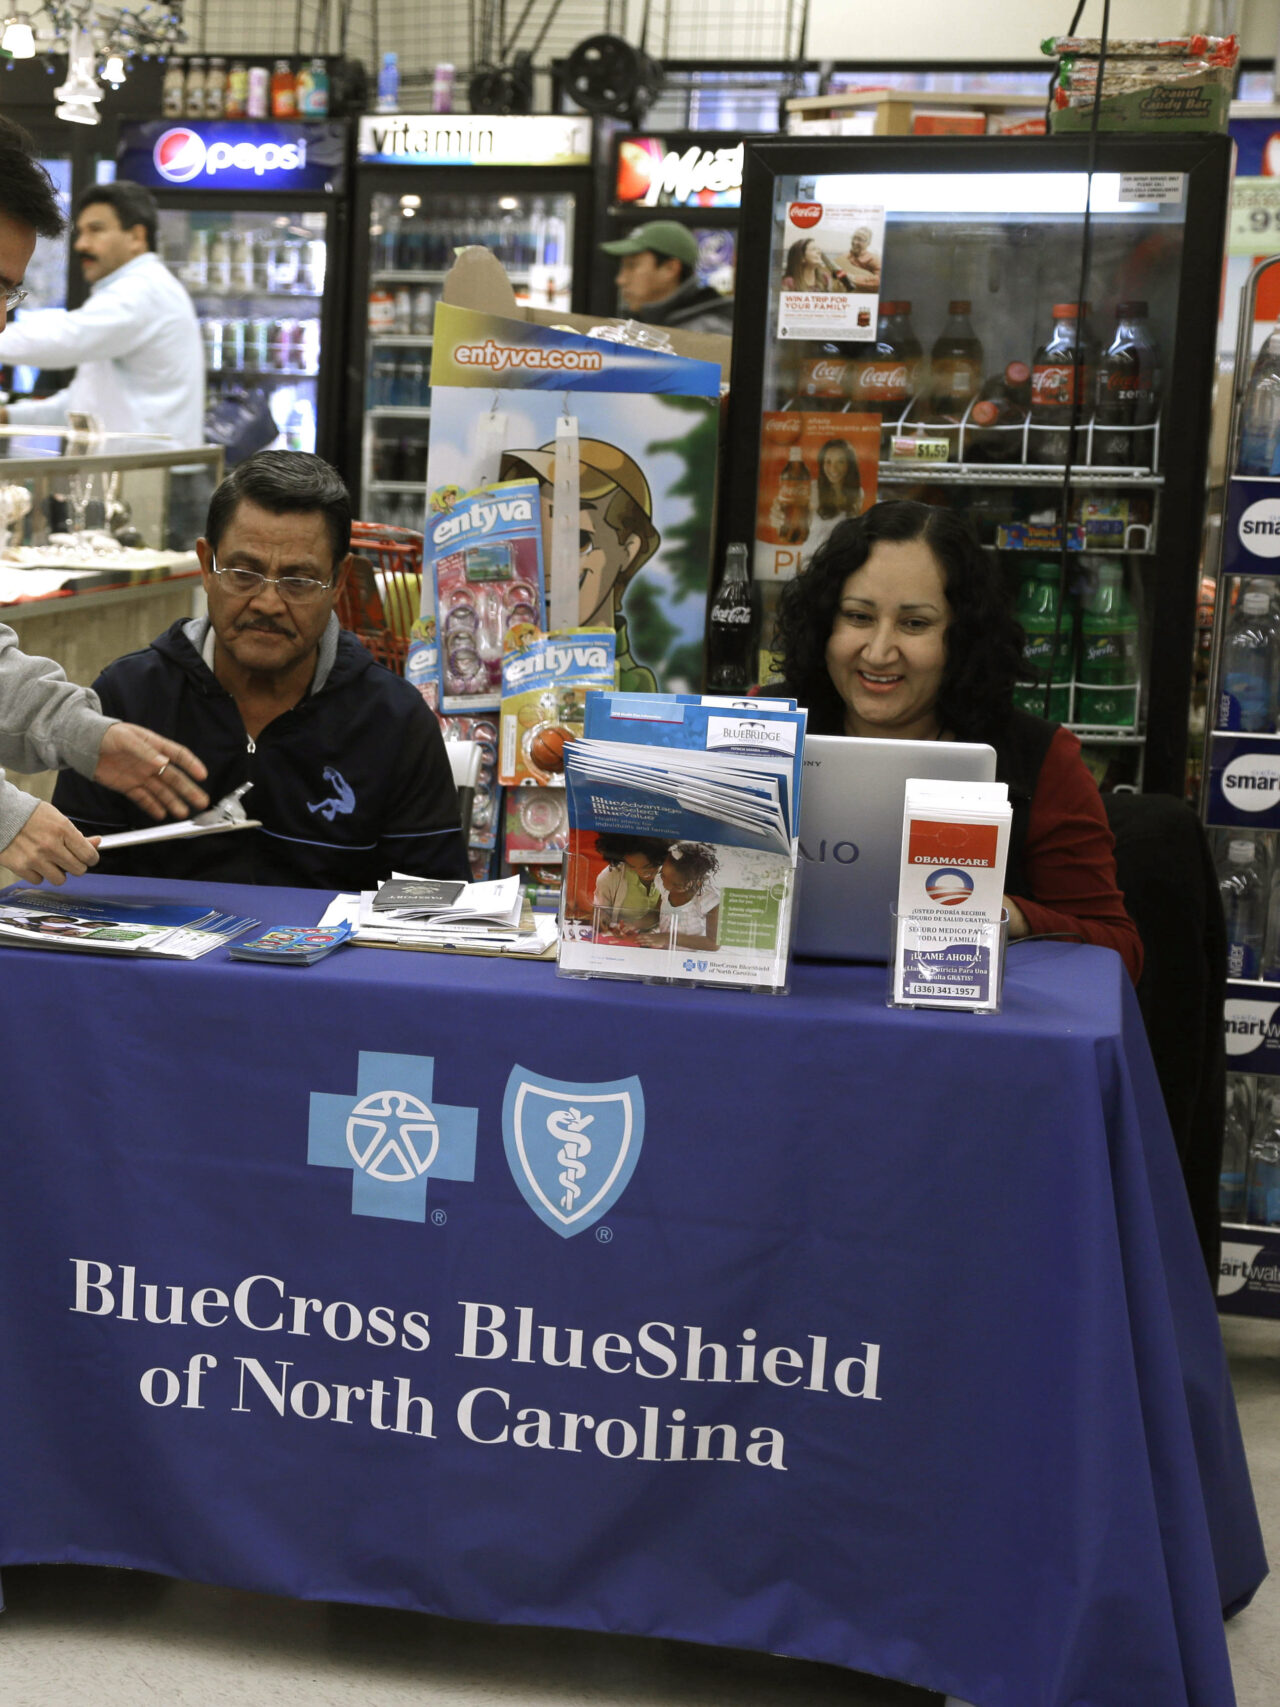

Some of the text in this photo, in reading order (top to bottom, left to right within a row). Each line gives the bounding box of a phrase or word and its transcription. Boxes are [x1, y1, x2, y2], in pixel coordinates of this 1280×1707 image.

[372, 121, 494, 155] vitamin
[206, 138, 306, 174] pepsi
[1236, 207, 1280, 234] .9
[784, 302, 811, 310] YOUR
[785, 295, 802, 303] WIN
[811, 295, 829, 303] TRIP
[830, 295, 848, 304] FOR
[454, 340, 603, 371] entyva.com
[433, 499, 533, 545] entyva
[505, 646, 608, 682] entyva
[1225, 773, 1280, 791] smar
[914, 855, 989, 867] OBAMACARE
[938, 927, 967, 935] MEDICO
[913, 984, 975, 996] (336) 341-1957
[918, 973, 946, 981] Coulta
[68, 1257, 883, 1402] BlueCross BlueShield
[138, 1353, 790, 1472] of North Carolina
